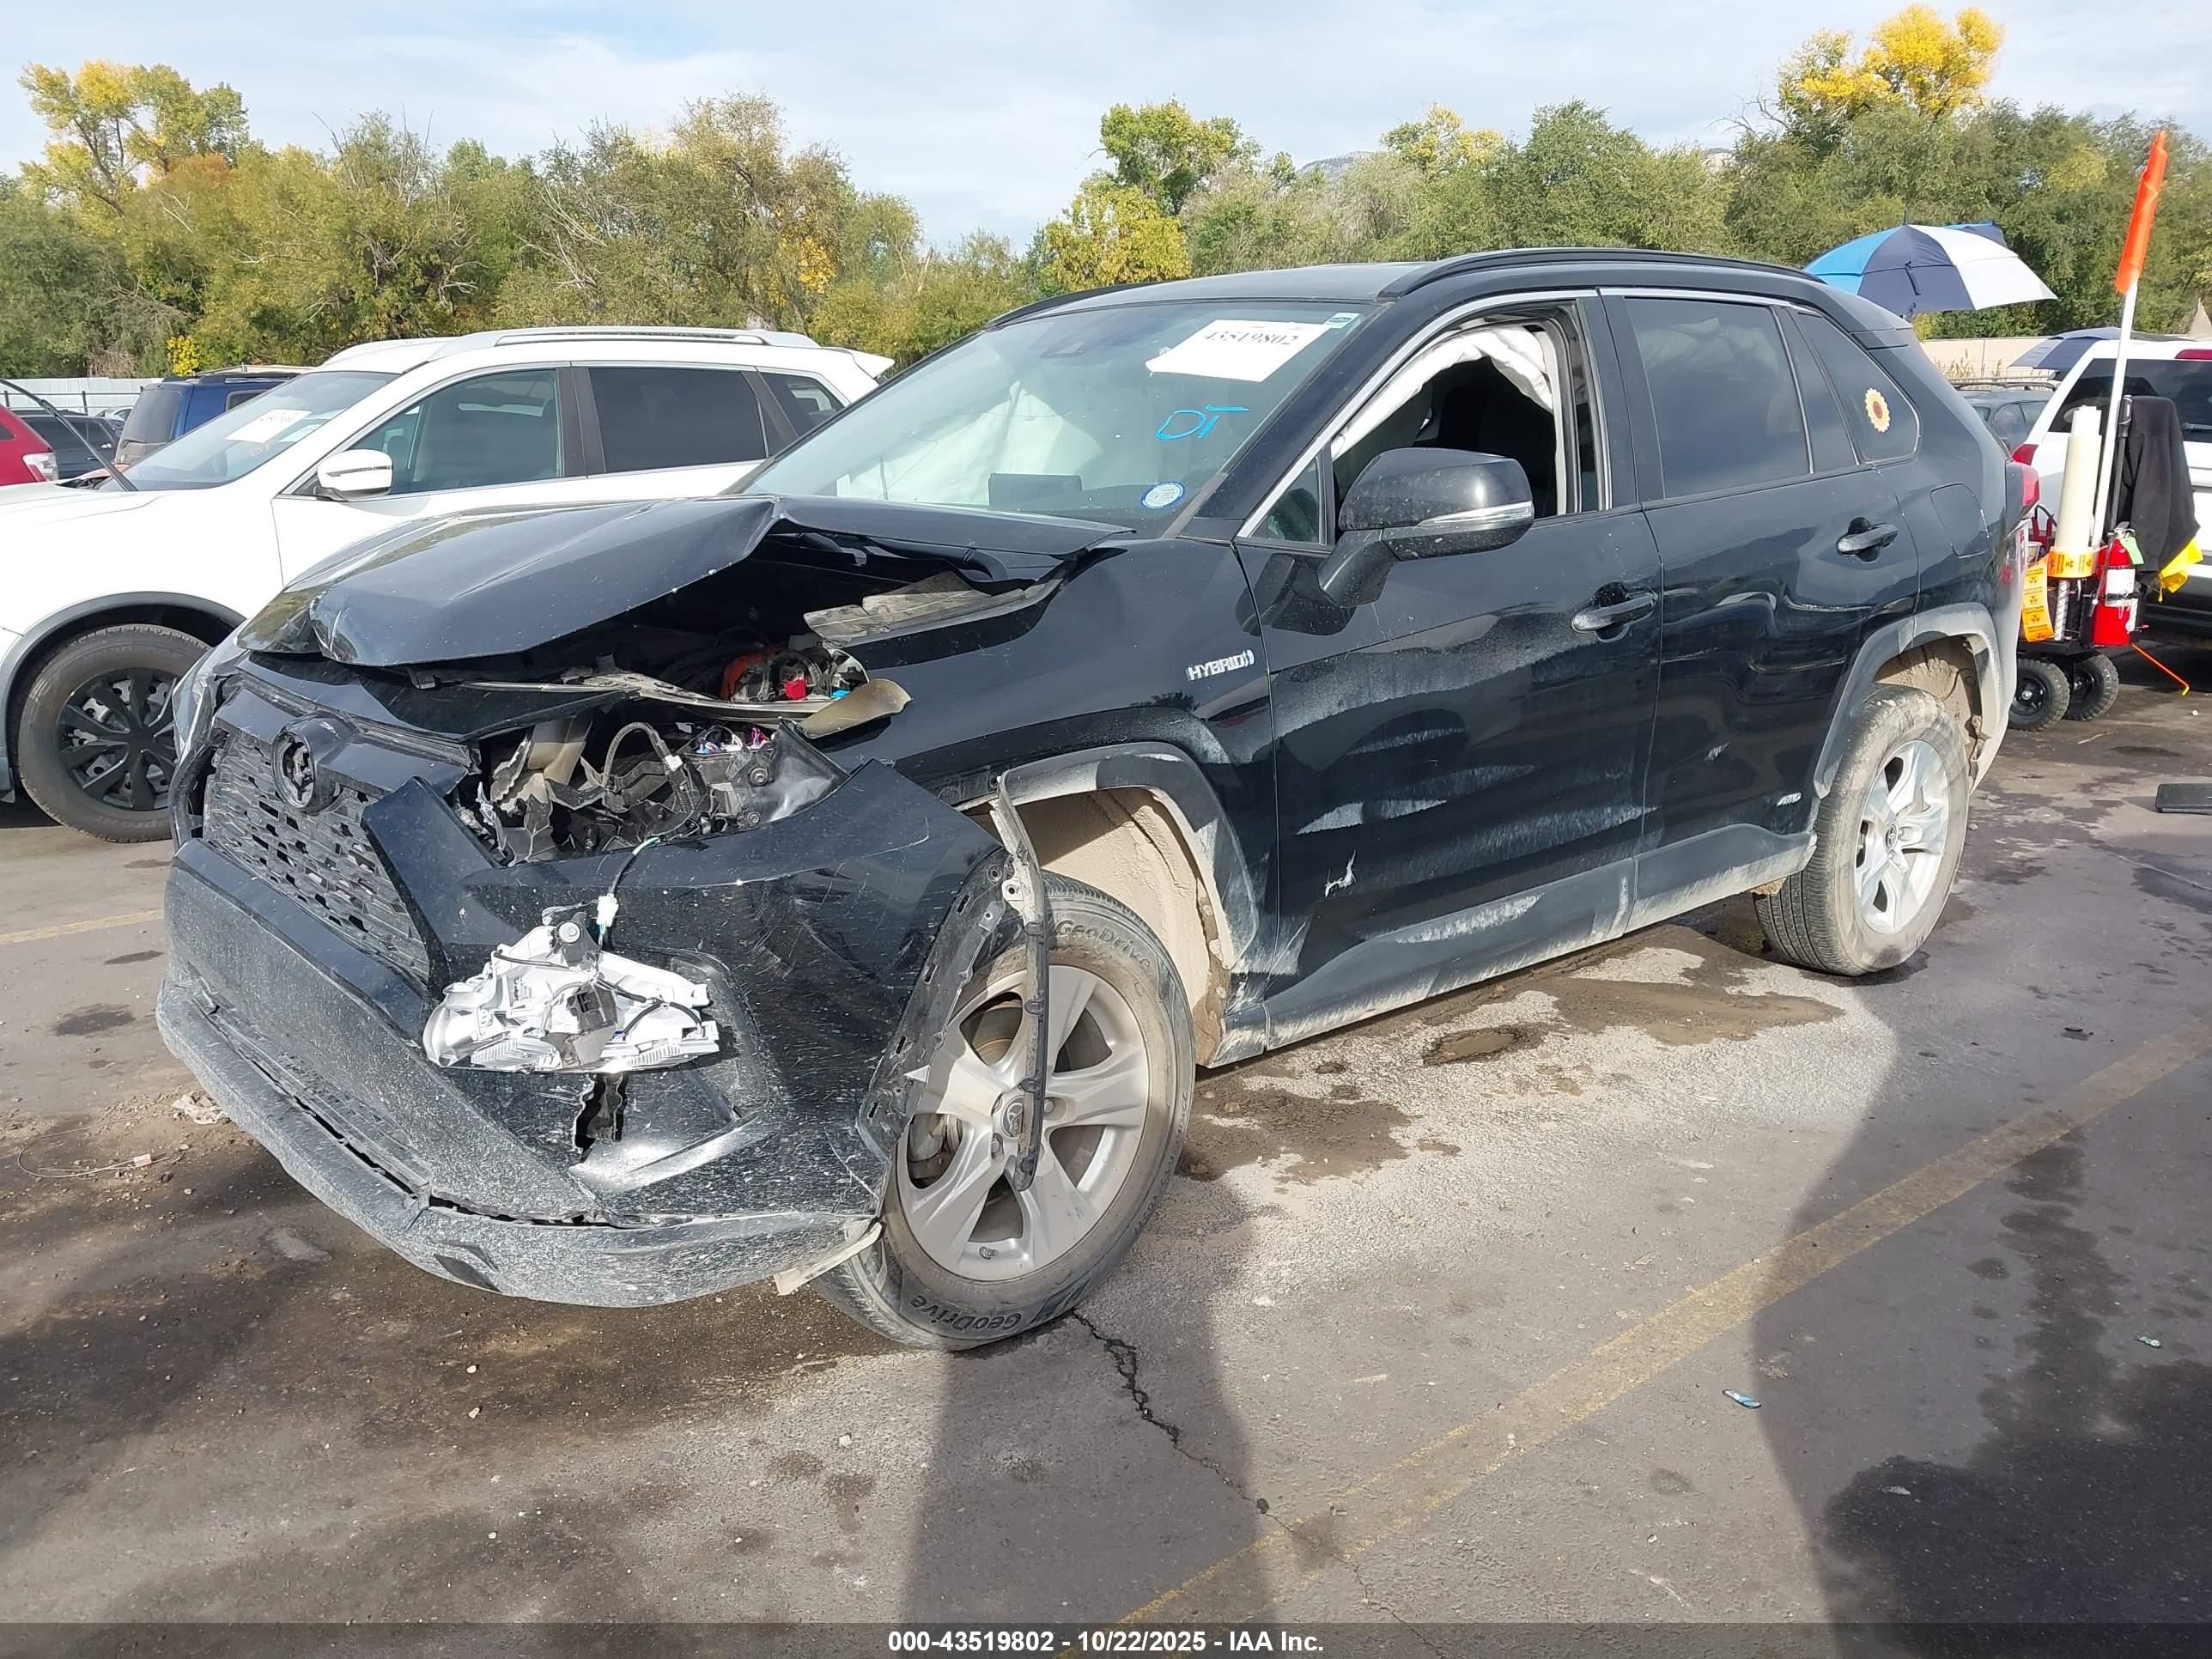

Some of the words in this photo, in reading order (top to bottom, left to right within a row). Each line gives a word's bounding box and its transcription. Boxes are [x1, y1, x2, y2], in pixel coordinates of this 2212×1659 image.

[1155, 404, 1251, 440] DT
[1186, 653, 1245, 681] HYBRID
[1055, 919, 1152, 971] GeoDrive
[909, 1294, 1024, 1331] GeoDrive
